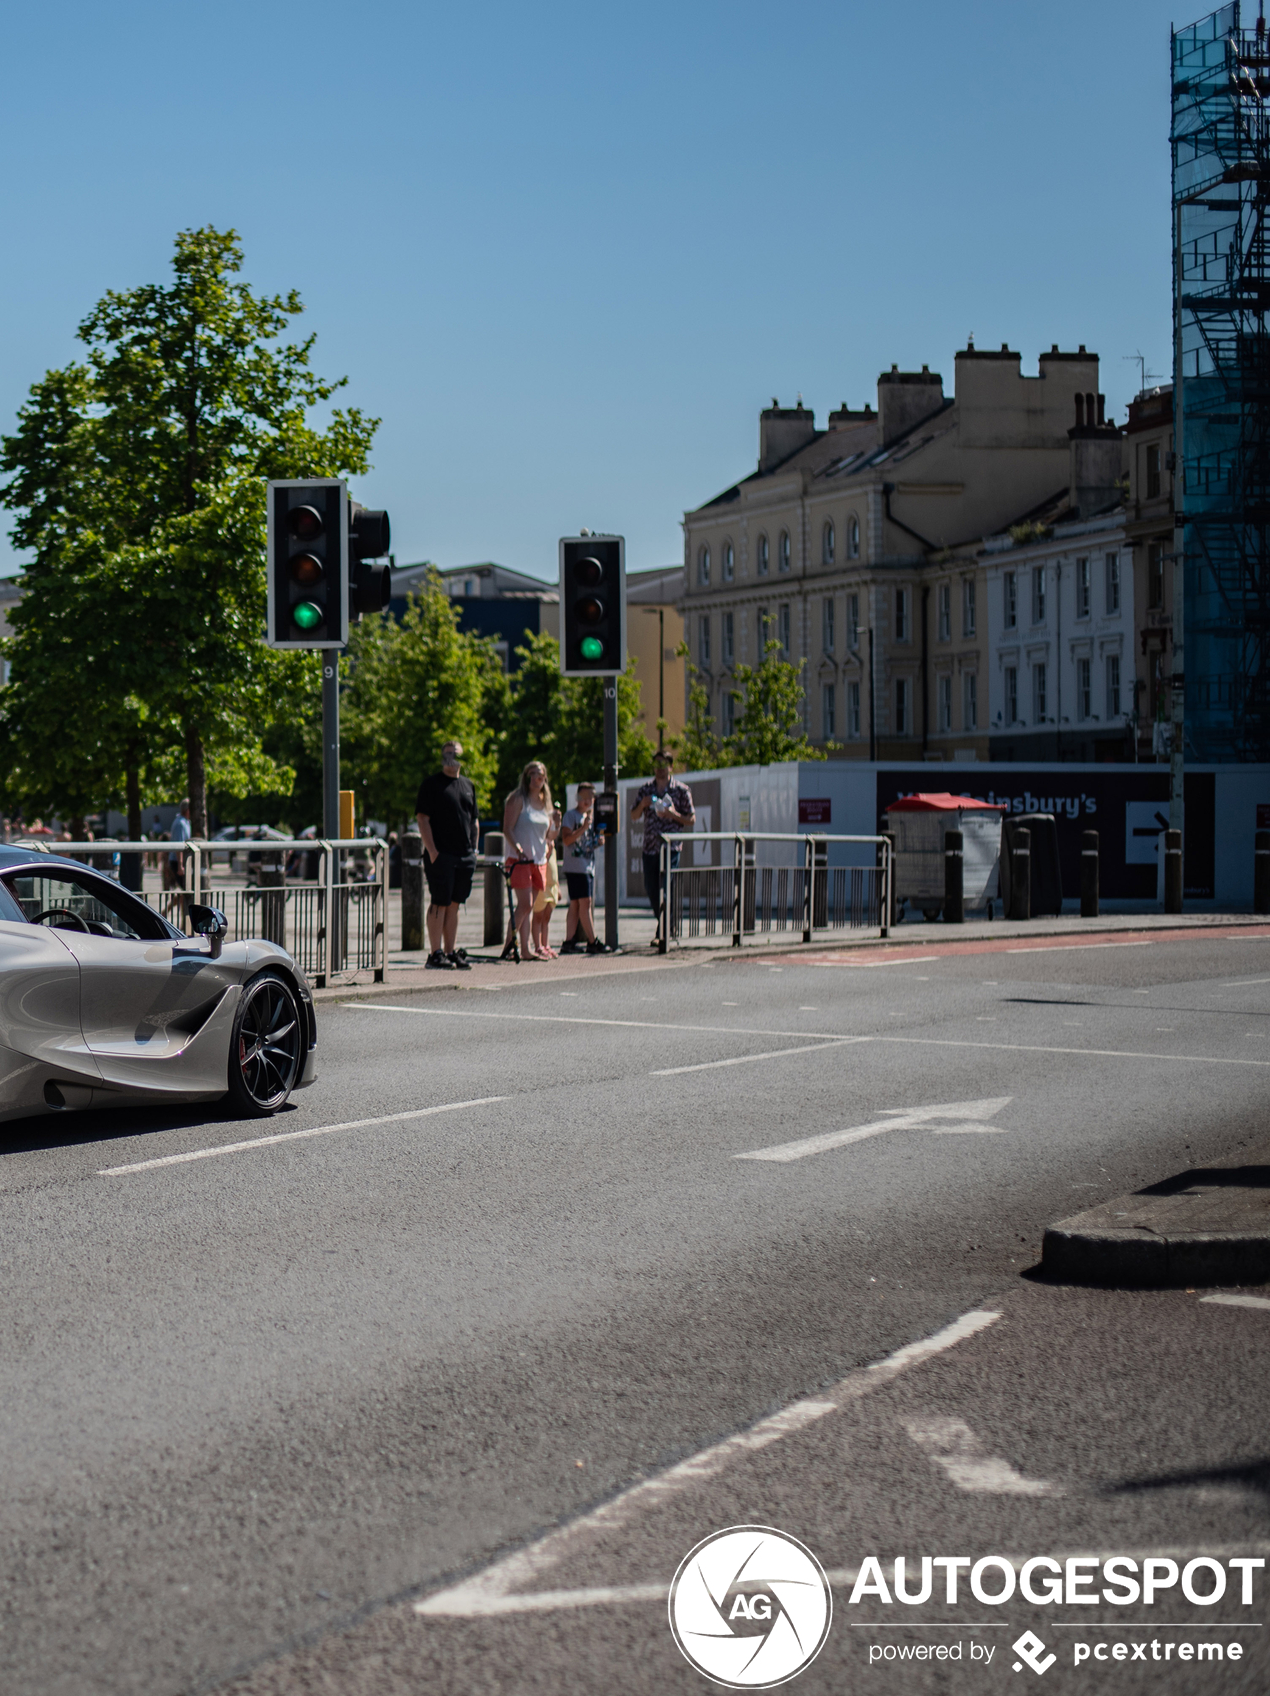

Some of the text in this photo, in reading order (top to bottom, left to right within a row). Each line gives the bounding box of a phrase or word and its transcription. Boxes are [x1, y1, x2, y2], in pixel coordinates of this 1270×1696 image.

[324, 666, 333, 679] 9
[604, 687, 616, 700] 10
[960, 791, 1098, 820] insbury's
